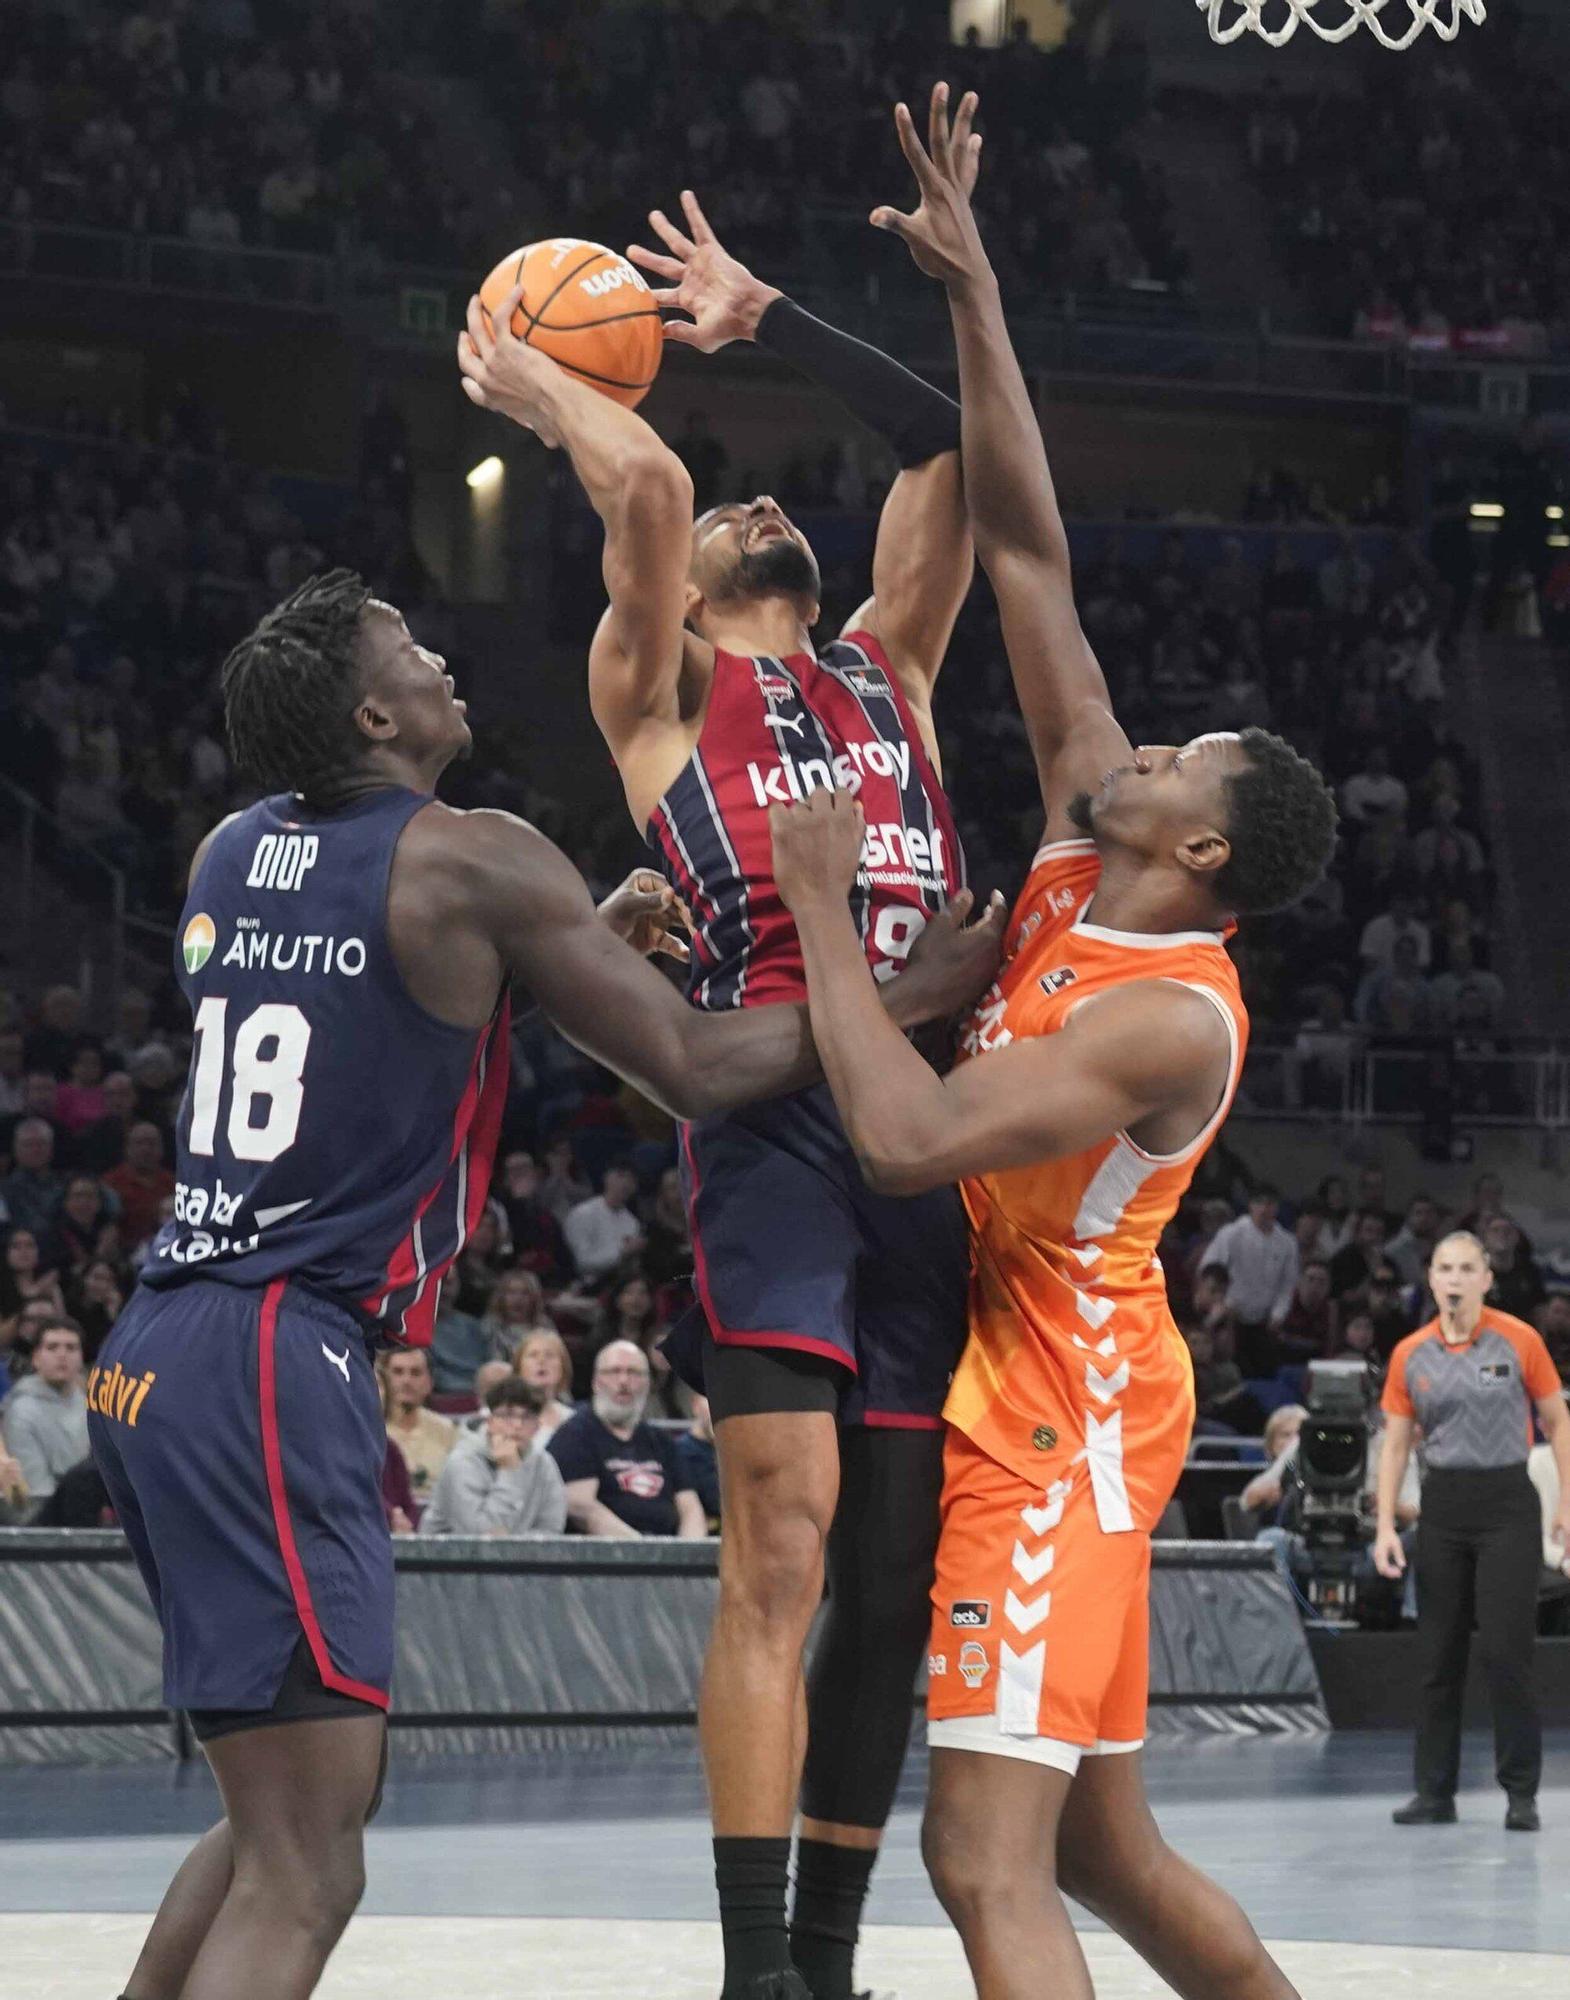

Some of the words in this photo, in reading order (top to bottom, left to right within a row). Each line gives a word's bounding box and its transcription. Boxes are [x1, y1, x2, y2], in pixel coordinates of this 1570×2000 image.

[246, 834, 319, 891] DIOP
[236, 916, 261, 930] GRUPO
[222, 931, 367, 977] AMUTIO
[189, 997, 312, 1162] 18
[952, 1610, 981, 1625] acb
